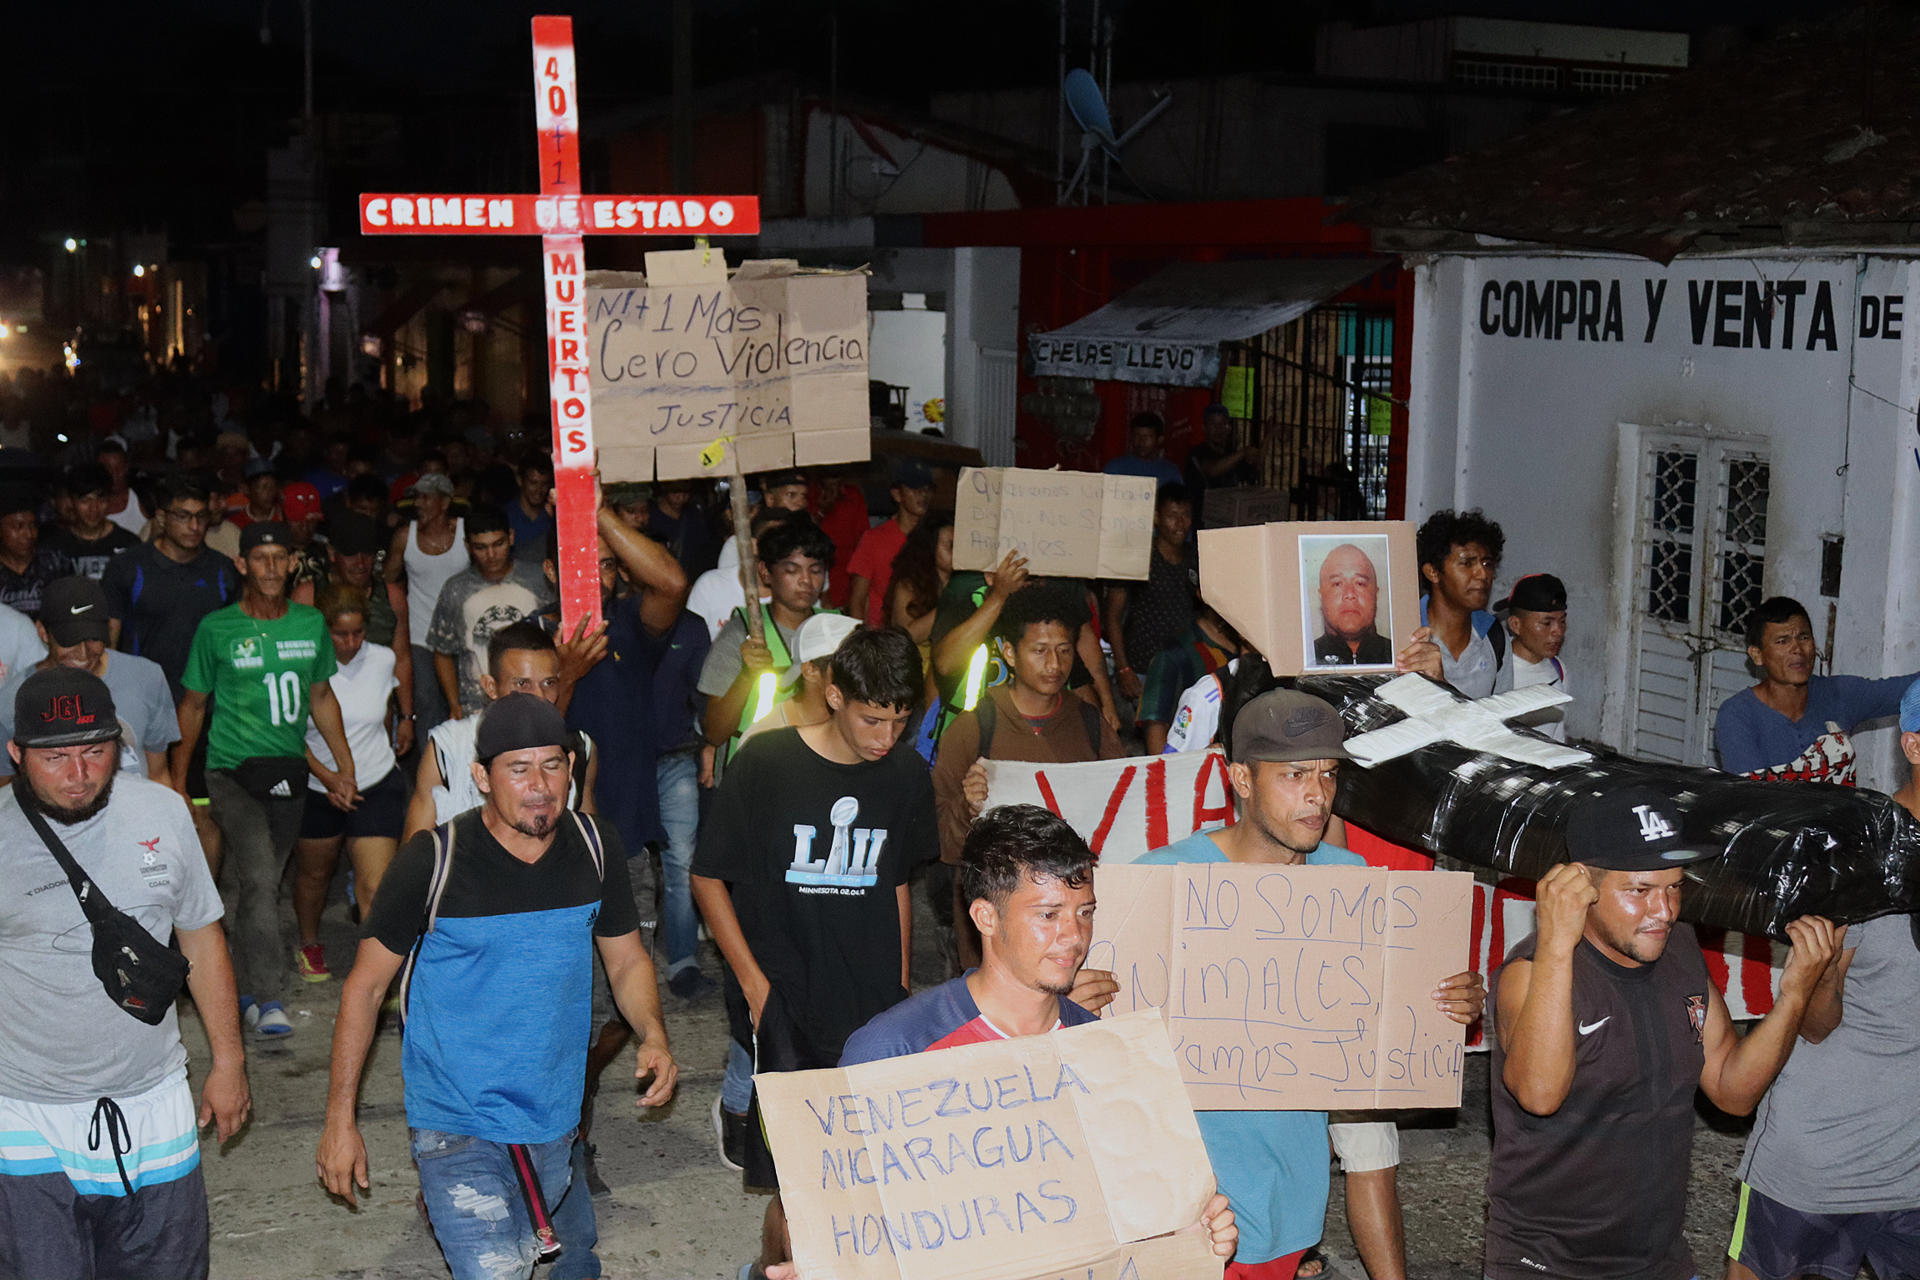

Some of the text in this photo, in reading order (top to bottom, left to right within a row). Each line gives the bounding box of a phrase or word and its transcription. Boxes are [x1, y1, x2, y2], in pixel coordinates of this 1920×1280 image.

[365, 198, 735, 229] CRIMEN DE ESTADO
[685, 291, 761, 339] Mas
[1480, 279, 1904, 351] COMPRA Y VENTA DE
[551, 253, 587, 454] MUERTOS
[600, 313, 864, 382] Cero Violencia
[1036, 342, 1113, 366] CHELAS
[263, 671, 301, 727] 10
[1631, 804, 1677, 842] LA
[798, 886, 840, 895] MINNESOTA
[1187, 864, 1240, 928] NO
[805, 1064, 1091, 1136] VENEZUELA
[822, 1119, 1075, 1191] NICARAGUA
[831, 1179, 1078, 1257] HONDURAS
